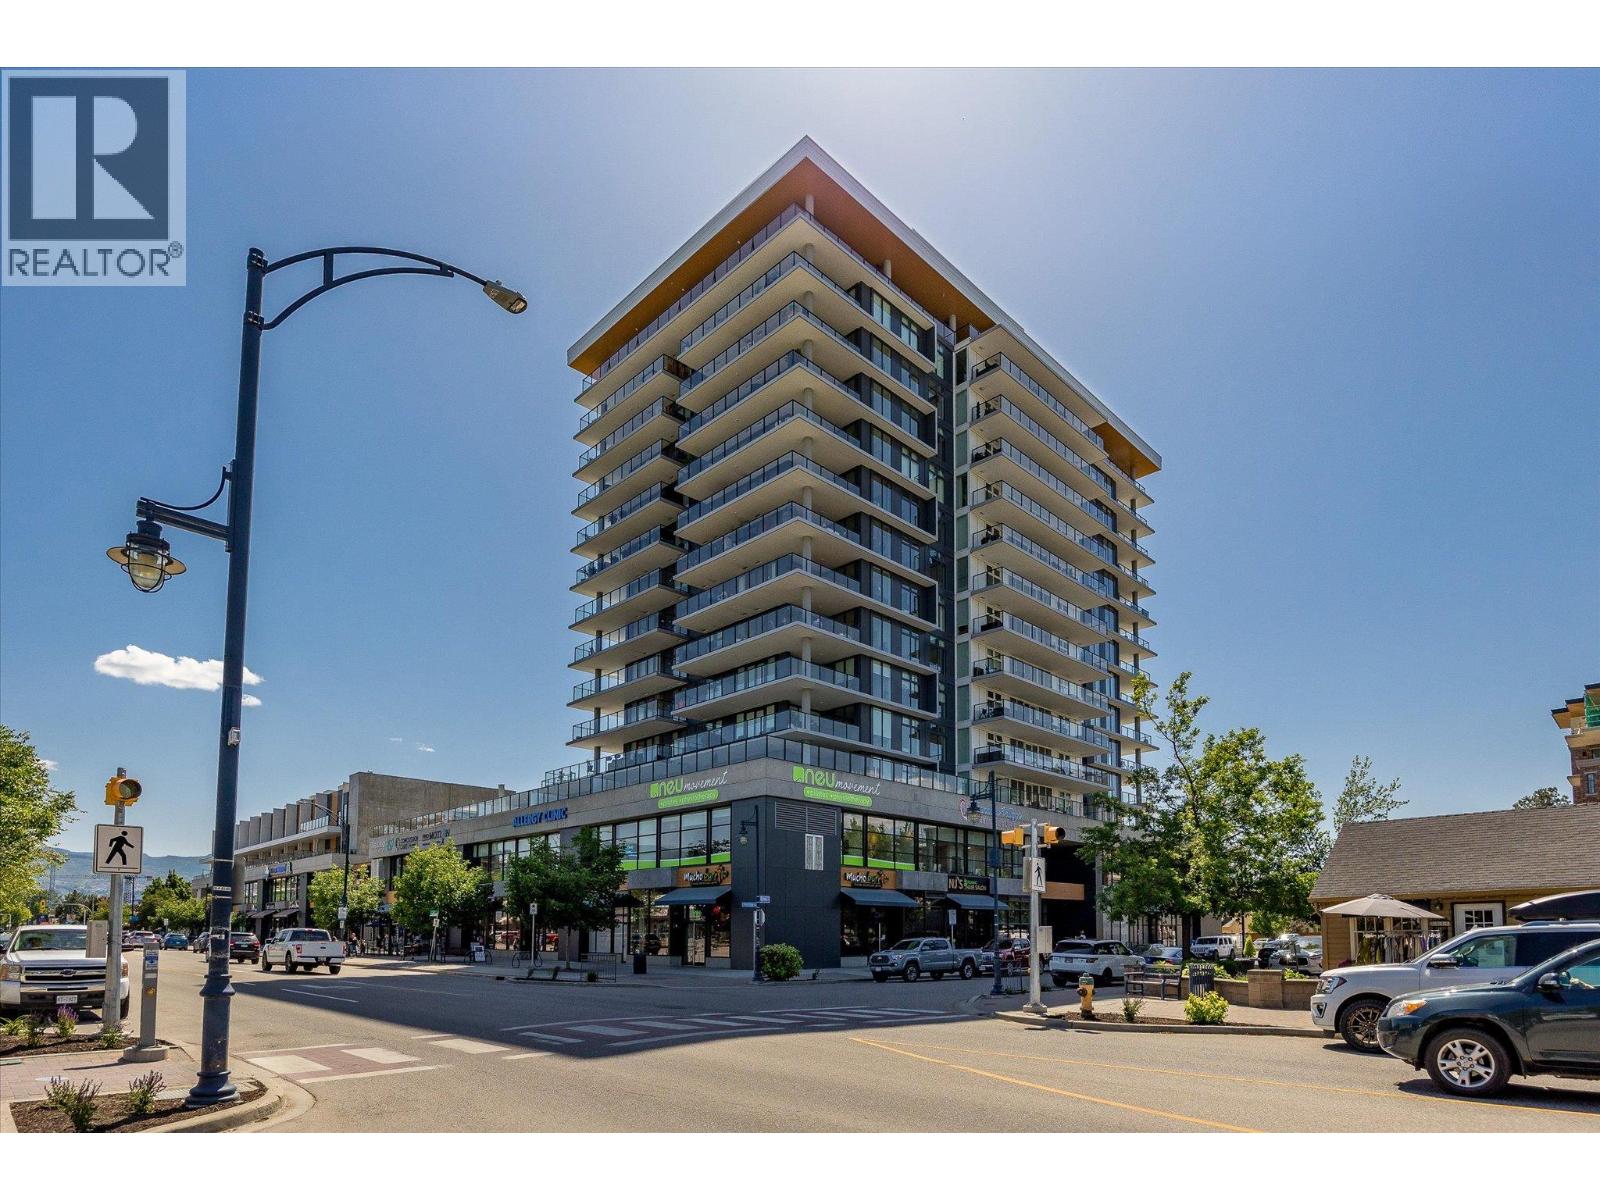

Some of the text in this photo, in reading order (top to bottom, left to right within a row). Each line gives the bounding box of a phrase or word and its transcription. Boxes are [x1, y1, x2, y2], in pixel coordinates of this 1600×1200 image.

[683, 769, 728, 791] movement
[835, 780, 881, 796] movement
[512, 808, 568, 827] ALLERGY CLINIC
